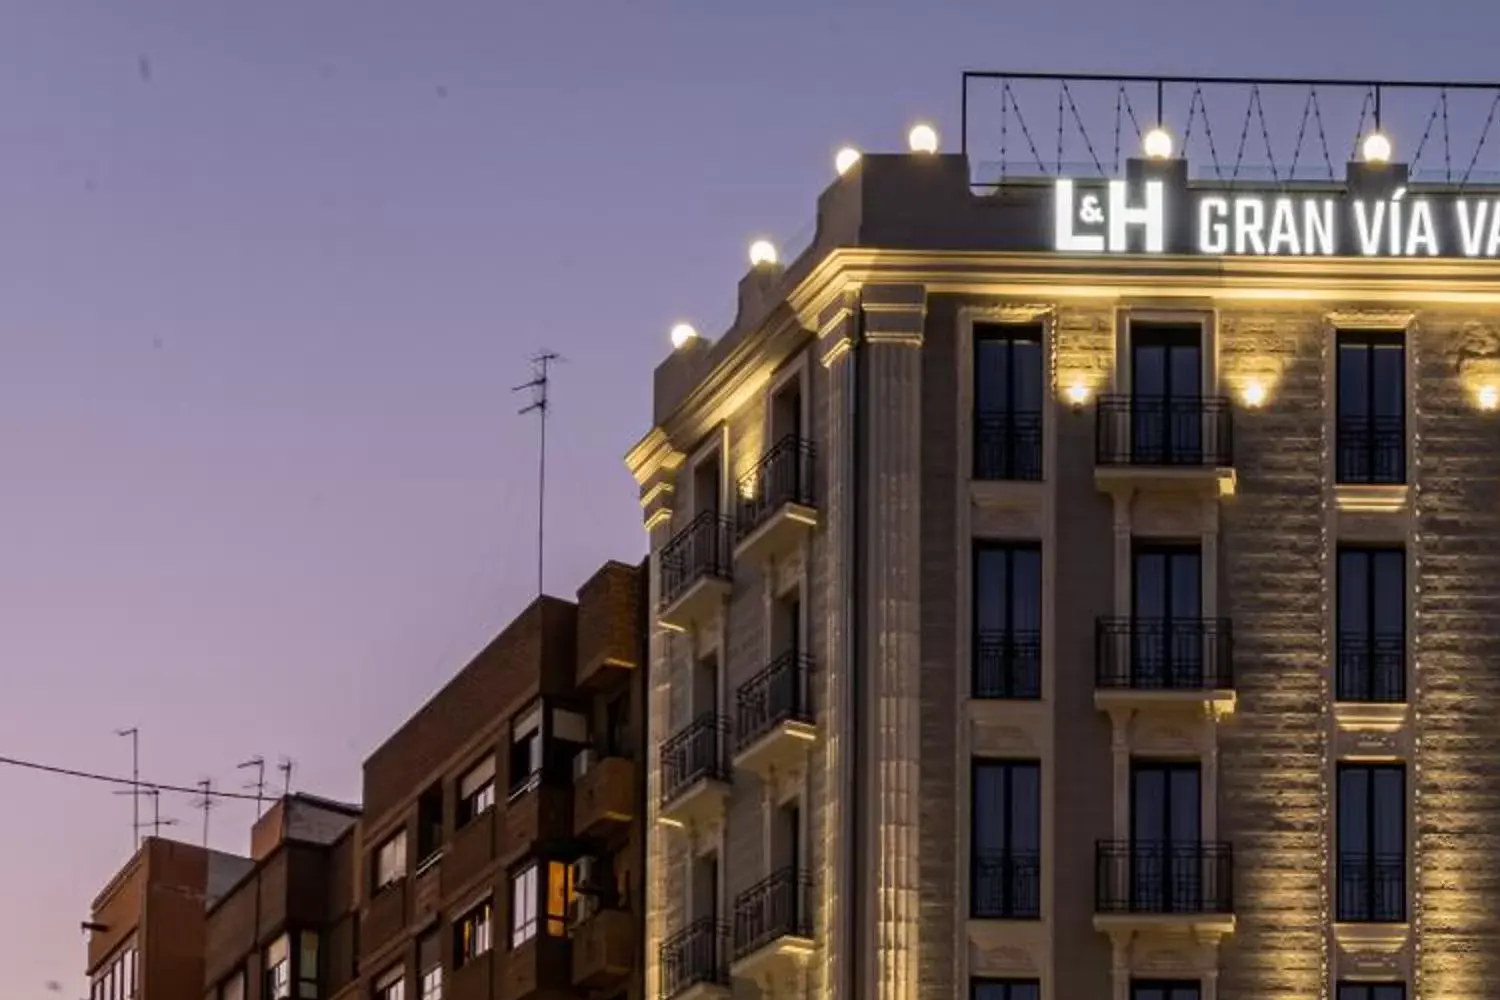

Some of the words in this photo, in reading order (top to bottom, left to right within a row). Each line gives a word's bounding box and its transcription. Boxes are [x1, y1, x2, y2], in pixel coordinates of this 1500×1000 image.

[1055, 179, 1164, 252] L&H
[1200, 198, 1334, 255] GRAN
[1353, 187, 1440, 257] VÍA
